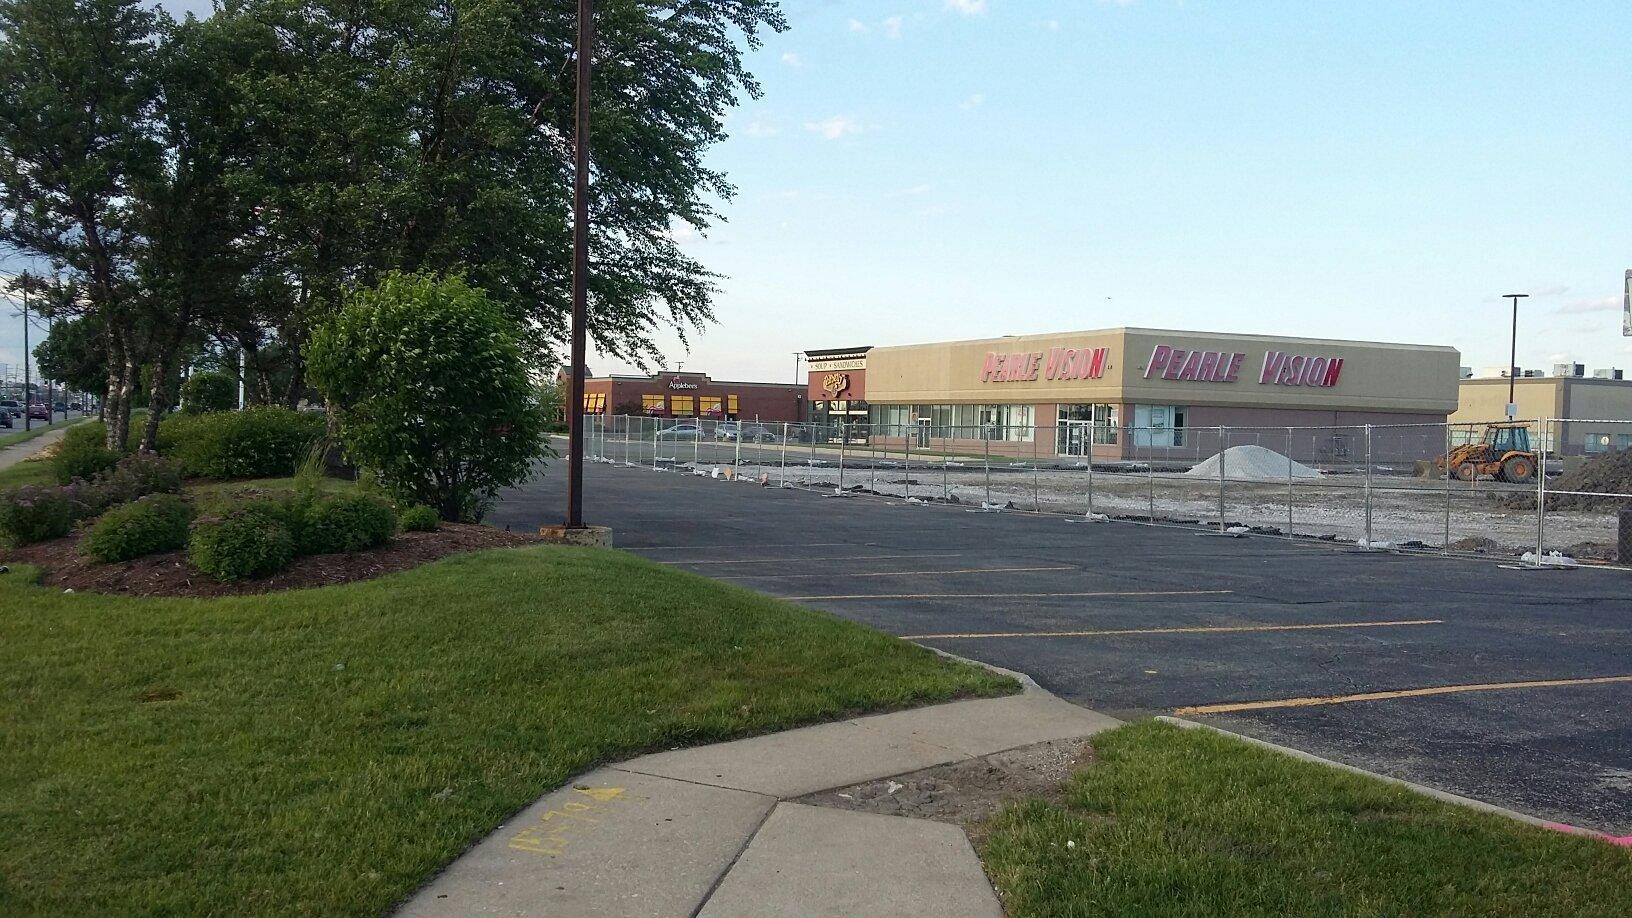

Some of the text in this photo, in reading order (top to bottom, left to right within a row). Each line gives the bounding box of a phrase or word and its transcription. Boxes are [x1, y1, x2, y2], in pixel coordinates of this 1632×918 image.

[833, 360, 864, 369] SANDWICHES
[979, 347, 1109, 383] PEARLE VISION
[1143, 345, 1344, 387] PEARLE VISION
